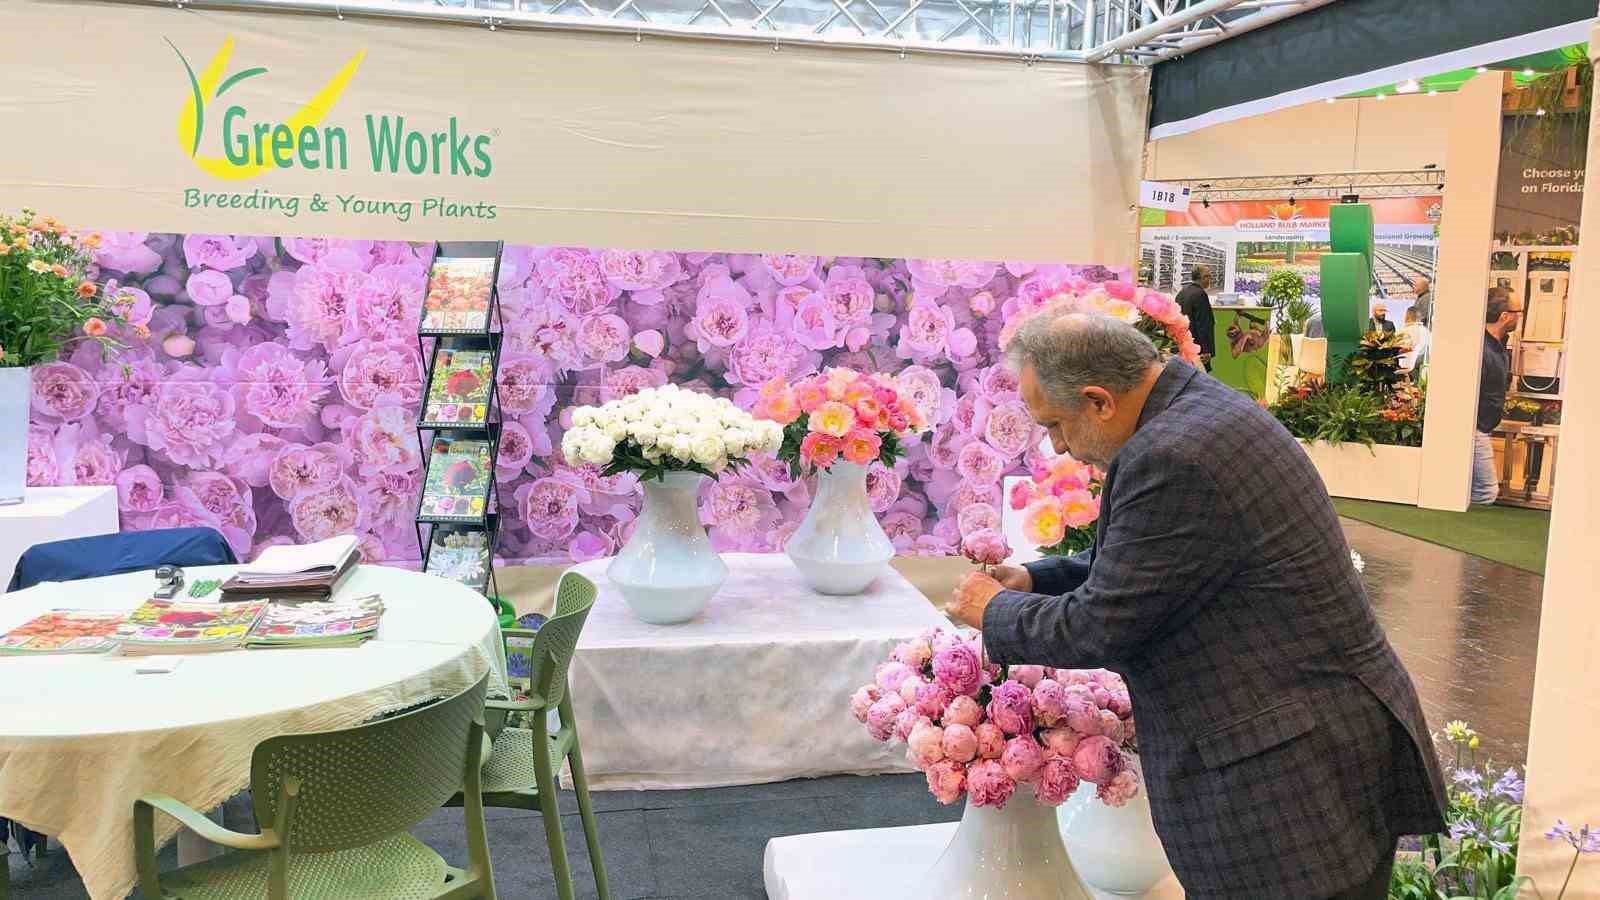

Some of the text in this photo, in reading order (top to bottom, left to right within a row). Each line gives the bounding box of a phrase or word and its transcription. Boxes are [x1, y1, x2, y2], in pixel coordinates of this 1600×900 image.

[223, 105, 492, 177] Green Works
[1523, 168, 1571, 178] Choose
[1521, 184, 1538, 193] on
[1152, 190, 1175, 203] 1B18
[183, 188, 497, 222] Breeding & Young Plants
[1278, 221, 1298, 229] BULB
